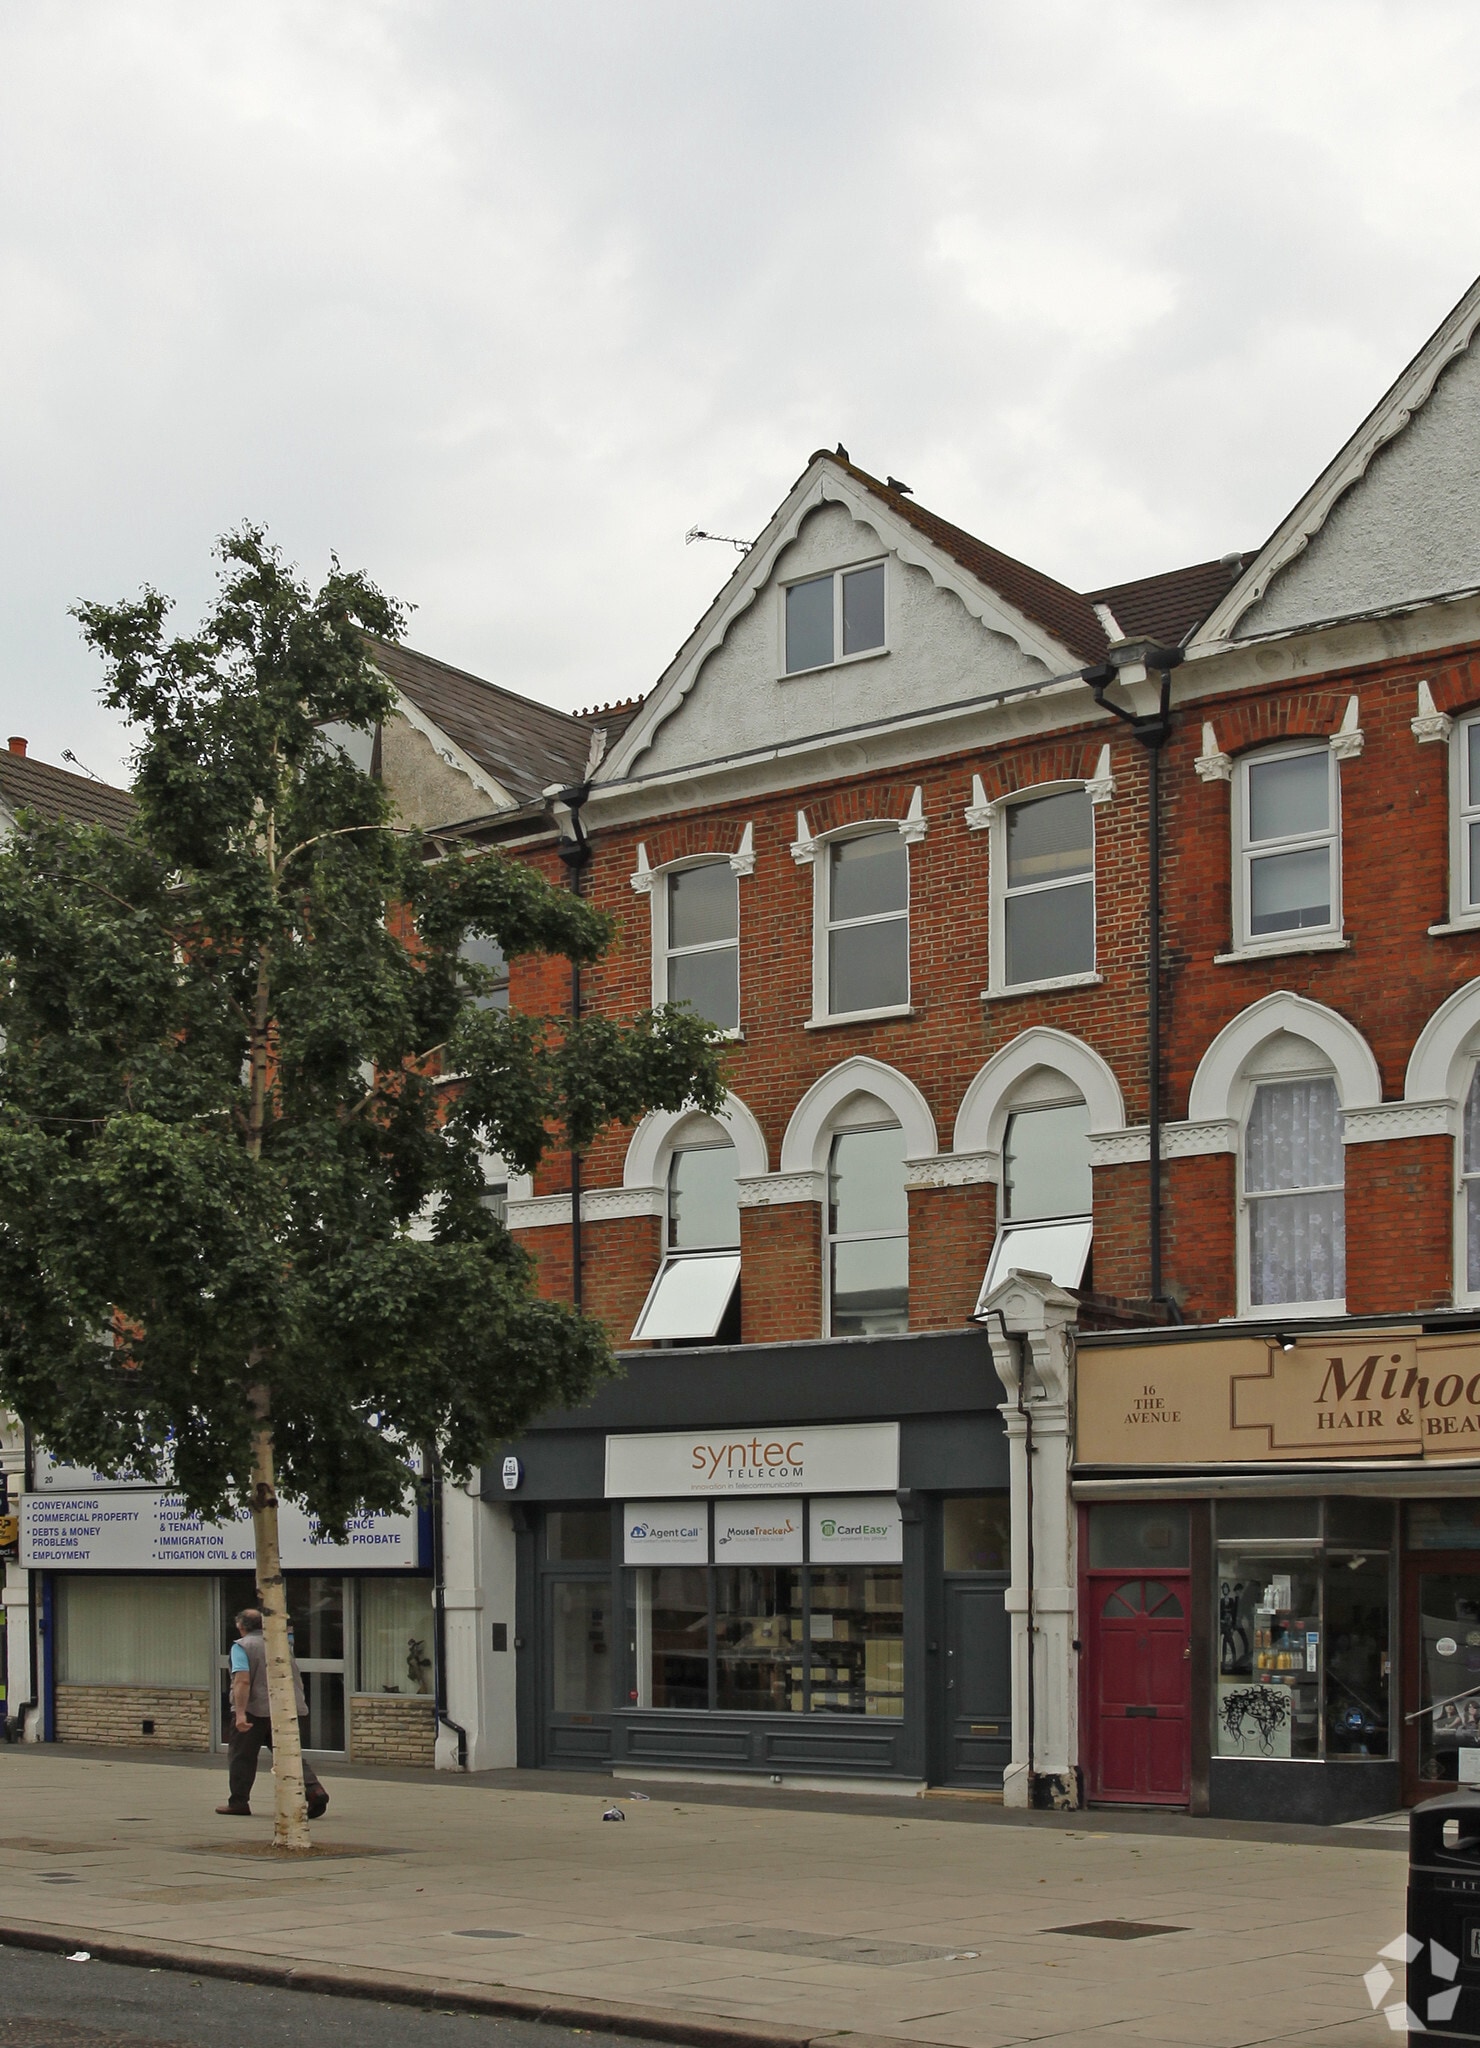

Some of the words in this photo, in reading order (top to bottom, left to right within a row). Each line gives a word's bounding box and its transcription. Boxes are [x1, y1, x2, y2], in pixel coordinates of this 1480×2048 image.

[1143, 1385, 1156, 1396] 16
[1134, 1398, 1165, 1410] THE
[1124, 1411, 1181, 1424] AVENUE
[1317, 1410, 1384, 1429] HAIR
[1396, 1408, 1414, 1425] &
[692, 1437, 804, 1479] syntec
[728, 1467, 803, 1478] TELECOM
[45, 1476, 53, 1484] 20
[32, 1501, 99, 1510] CONVEYANCING
[32, 1513, 90, 1522] COMMERCIAL
[92, 1512, 139, 1521] PROPERTY
[32, 1528, 59, 1536] DEBTS
[61, 1527, 67, 1536] &
[70, 1527, 101, 1536] MONEY
[160, 1522, 165, 1531] &
[169, 1522, 205, 1531] TENANT
[32, 1538, 78, 1547] PROBLEMS
[160, 1536, 224, 1545] IMMIGRATION
[352, 1534, 401, 1544] PROBATE
[32, 1550, 90, 1560] EMPLOYMENT
[158, 1551, 205, 1560] LITIGATION
[207, 1550, 229, 1560] CIVIL
[231, 1551, 237, 1560] &
